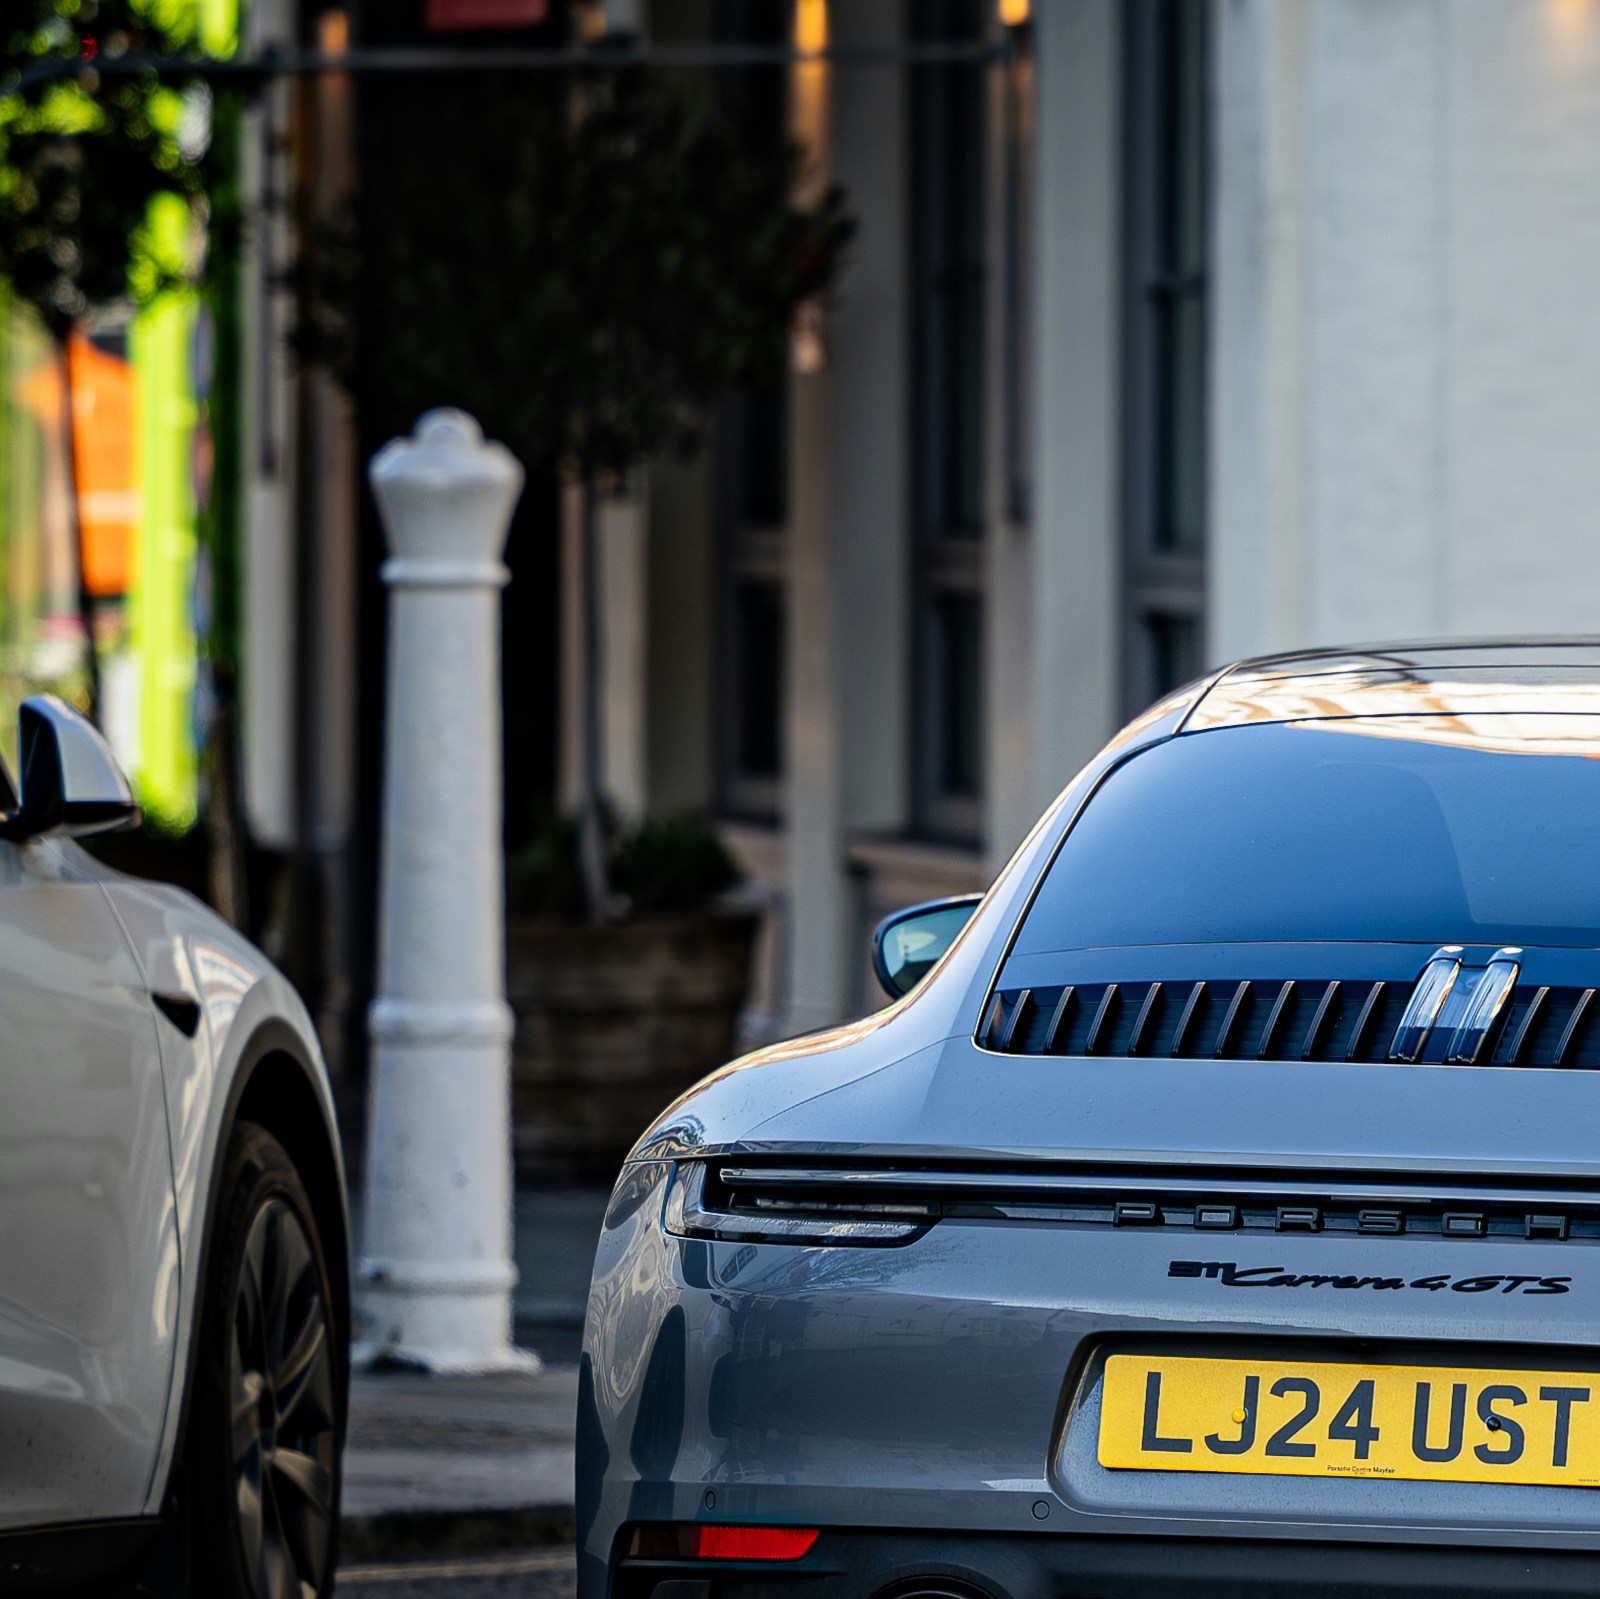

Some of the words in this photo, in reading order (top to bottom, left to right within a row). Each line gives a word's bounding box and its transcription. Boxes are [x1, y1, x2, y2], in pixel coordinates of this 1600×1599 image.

[1222, 1266, 1406, 1290] Carrera
[1409, 1274, 1452, 1292] 4
[1450, 1274, 1573, 1295] GTS
[1140, 1370, 1381, 1461] LJ24
[1411, 1381, 1592, 1468] UST
